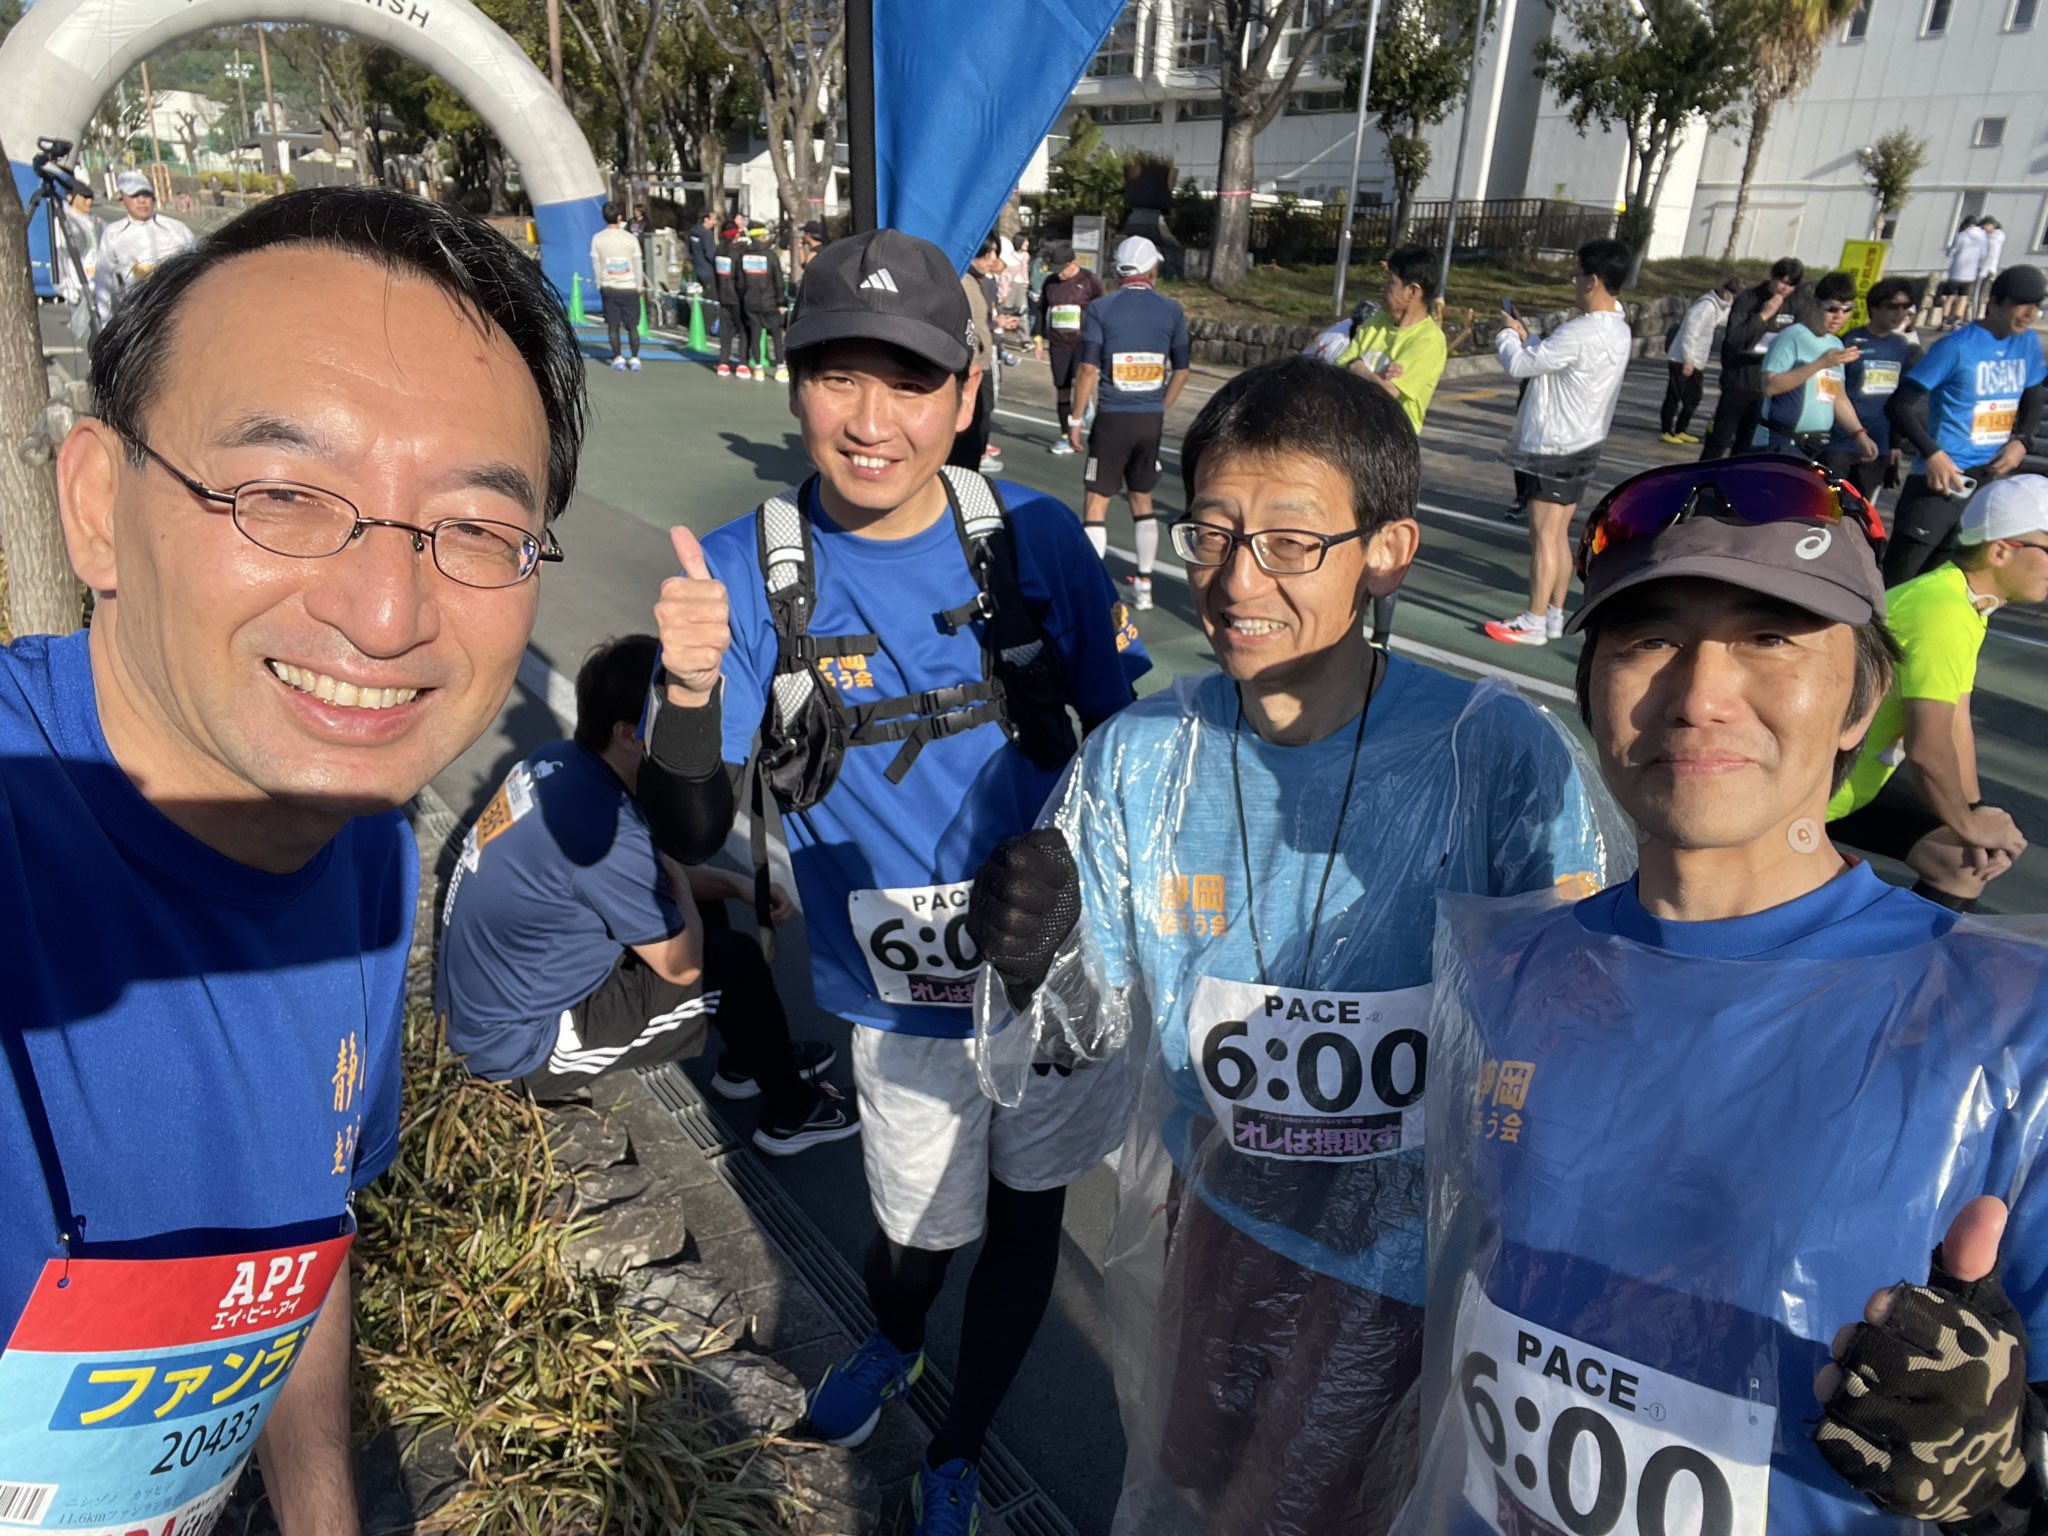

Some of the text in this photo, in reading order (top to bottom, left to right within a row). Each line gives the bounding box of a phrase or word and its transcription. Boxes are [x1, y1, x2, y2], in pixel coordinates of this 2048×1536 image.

[912, 889, 970, 912] PAC
[870, 912, 983, 972] 6:0
[1264, 994, 1361, 1024] PACE
[1202, 1020, 1429, 1114] 6:00
[219, 1250, 318, 1309] API
[80, 1325, 310, 1425] ファンラ
[1517, 1330, 1640, 1413] PACE
[150, 1402, 260, 1476] 20433
[1460, 1351, 1734, 1536] 6:00
